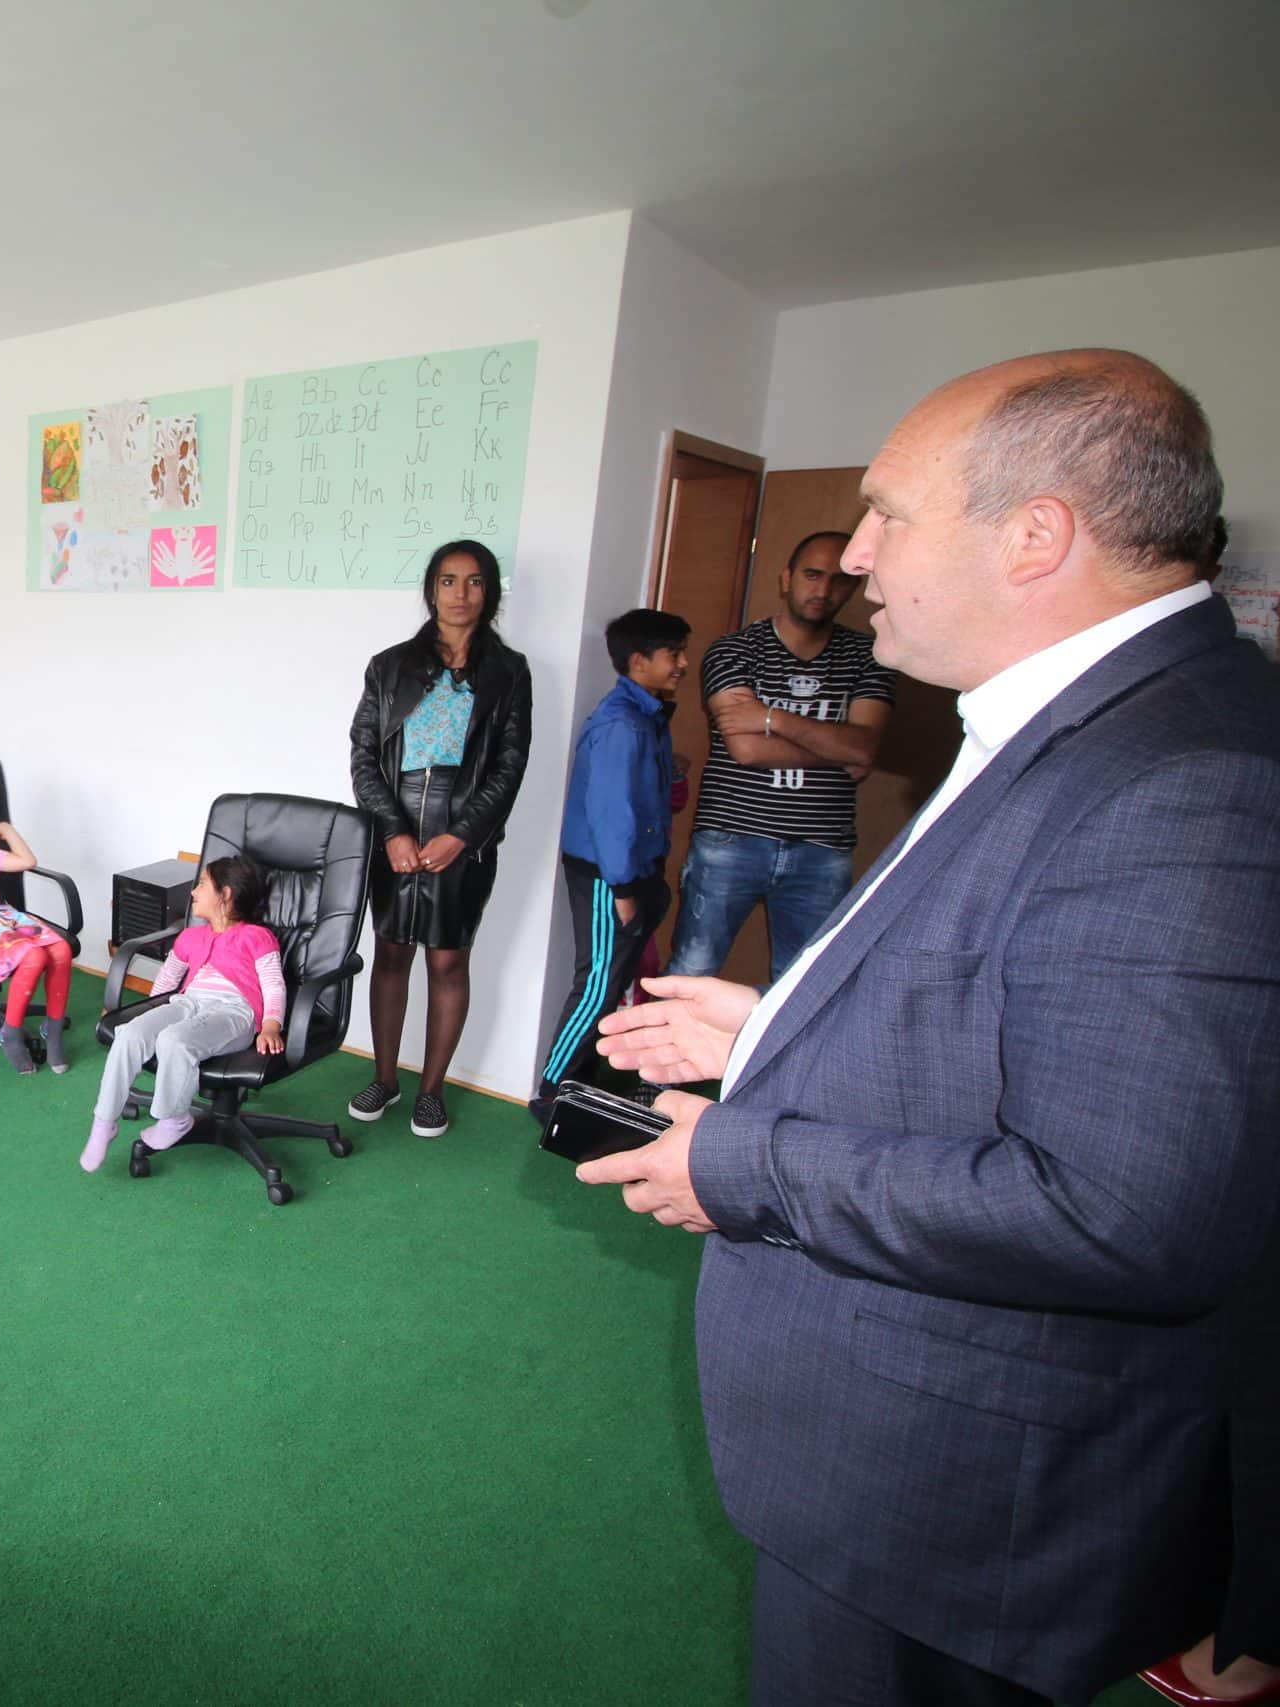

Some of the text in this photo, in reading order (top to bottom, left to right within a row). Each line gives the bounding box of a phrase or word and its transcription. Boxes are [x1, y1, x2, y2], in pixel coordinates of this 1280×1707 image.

[301, 375, 337, 406] Bb
[416, 396, 445, 429] Ee
[351, 476, 384, 505] Mm
